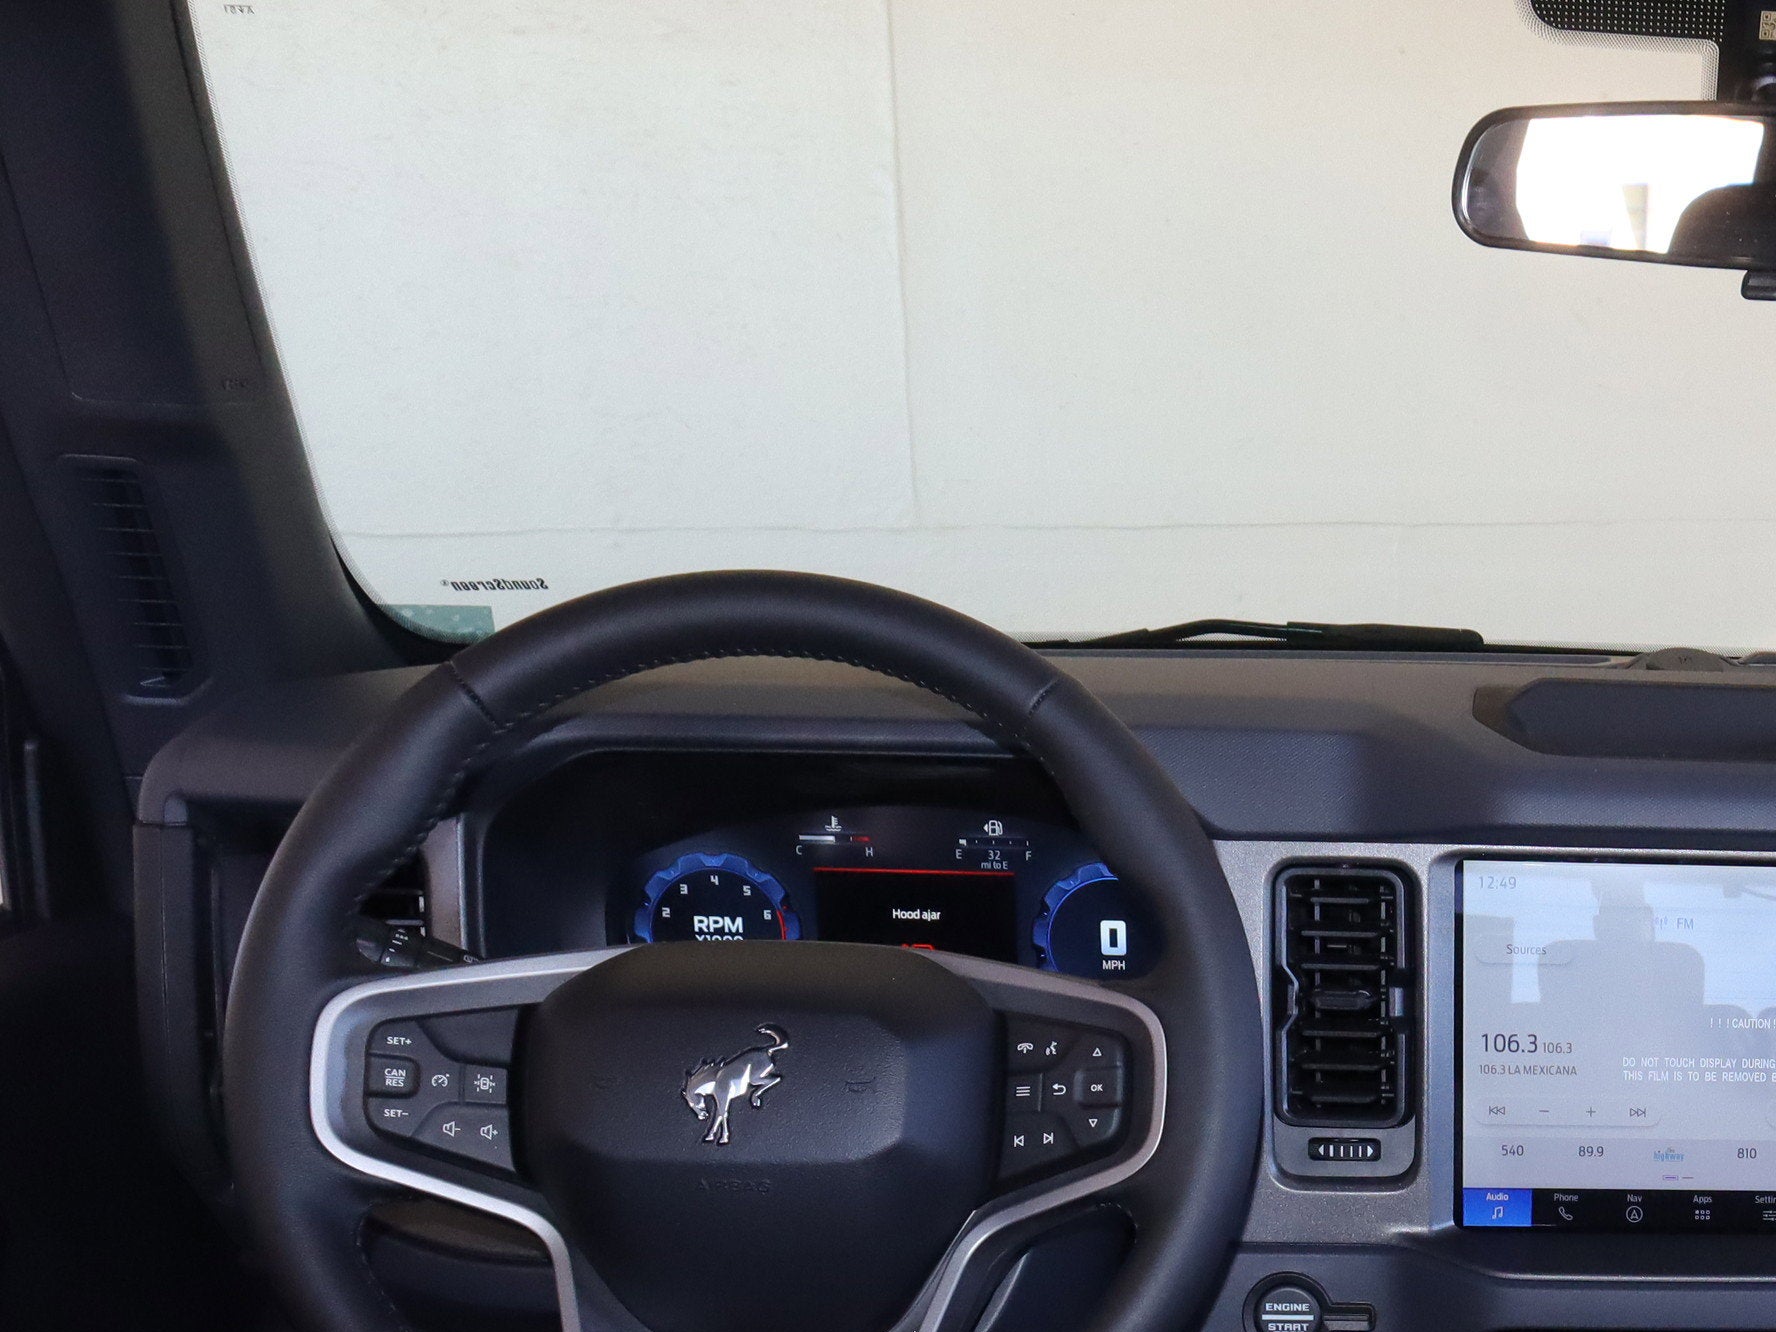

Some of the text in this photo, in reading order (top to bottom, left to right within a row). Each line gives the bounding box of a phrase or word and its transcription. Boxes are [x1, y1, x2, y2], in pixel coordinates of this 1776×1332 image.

[796, 845, 802, 855] C
[865, 847, 874, 857] H
[956, 849, 962, 859] E
[987, 850, 1000, 860] 32
[1025, 851, 1032, 861] F
[981, 860, 1008, 870] mi to E
[710, 875, 720, 885] 4
[1478, 876, 1517, 889] 12:49
[680, 884, 688, 895] 3
[743, 885, 751, 896] 5
[662, 907, 671, 918] 2
[764, 910, 772, 920] 6
[892, 909, 941, 922] Hood ajar
[693, 915, 743, 933] RPM
[1677, 918, 1694, 930] FM
[1100, 920, 1127, 956] 0
[1506, 943, 1547, 955] Sources
[1102, 960, 1125, 970] MPH
[387, 1036, 412, 1045] SET+
[1482, 1033, 1538, 1053] 106.3
[1543, 1042, 1572, 1053] 106.3
[1623, 1057, 1636, 1068] DO
[1641, 1057, 1660, 1068] NOT
[1665, 1057, 1695, 1068] TOUCH
[1700, 1058, 1737, 1069] DISPLAY
[1742, 1058, 1776, 1069] DURING
[384, 1068, 406, 1077] CAN
[1480, 1064, 1578, 1076] 106.3 LA MEXICANA
[1623, 1070, 1643, 1081] THIS
[1649, 1071, 1669, 1082] FILM
[1674, 1071, 1683, 1082] IS
[1688, 1071, 1700, 1082] TO
[1705, 1071, 1717, 1082] BE
[1722, 1072, 1767, 1082] REMOVED
[385, 1079, 405, 1087] RES
[1090, 1084, 1103, 1092] OK
[1501, 1145, 1524, 1156] 540
[1578, 1146, 1604, 1157] 89.9
[1737, 1148, 1757, 1159] 810
[1486, 1192, 1509, 1201] Audio
[1554, 1193, 1579, 1202] Phone
[1627, 1194, 1642, 1202] Nav
[1693, 1195, 1712, 1204] Apps
[1265, 1303, 1310, 1311] ENGINE
[1268, 1323, 1309, 1331] START
